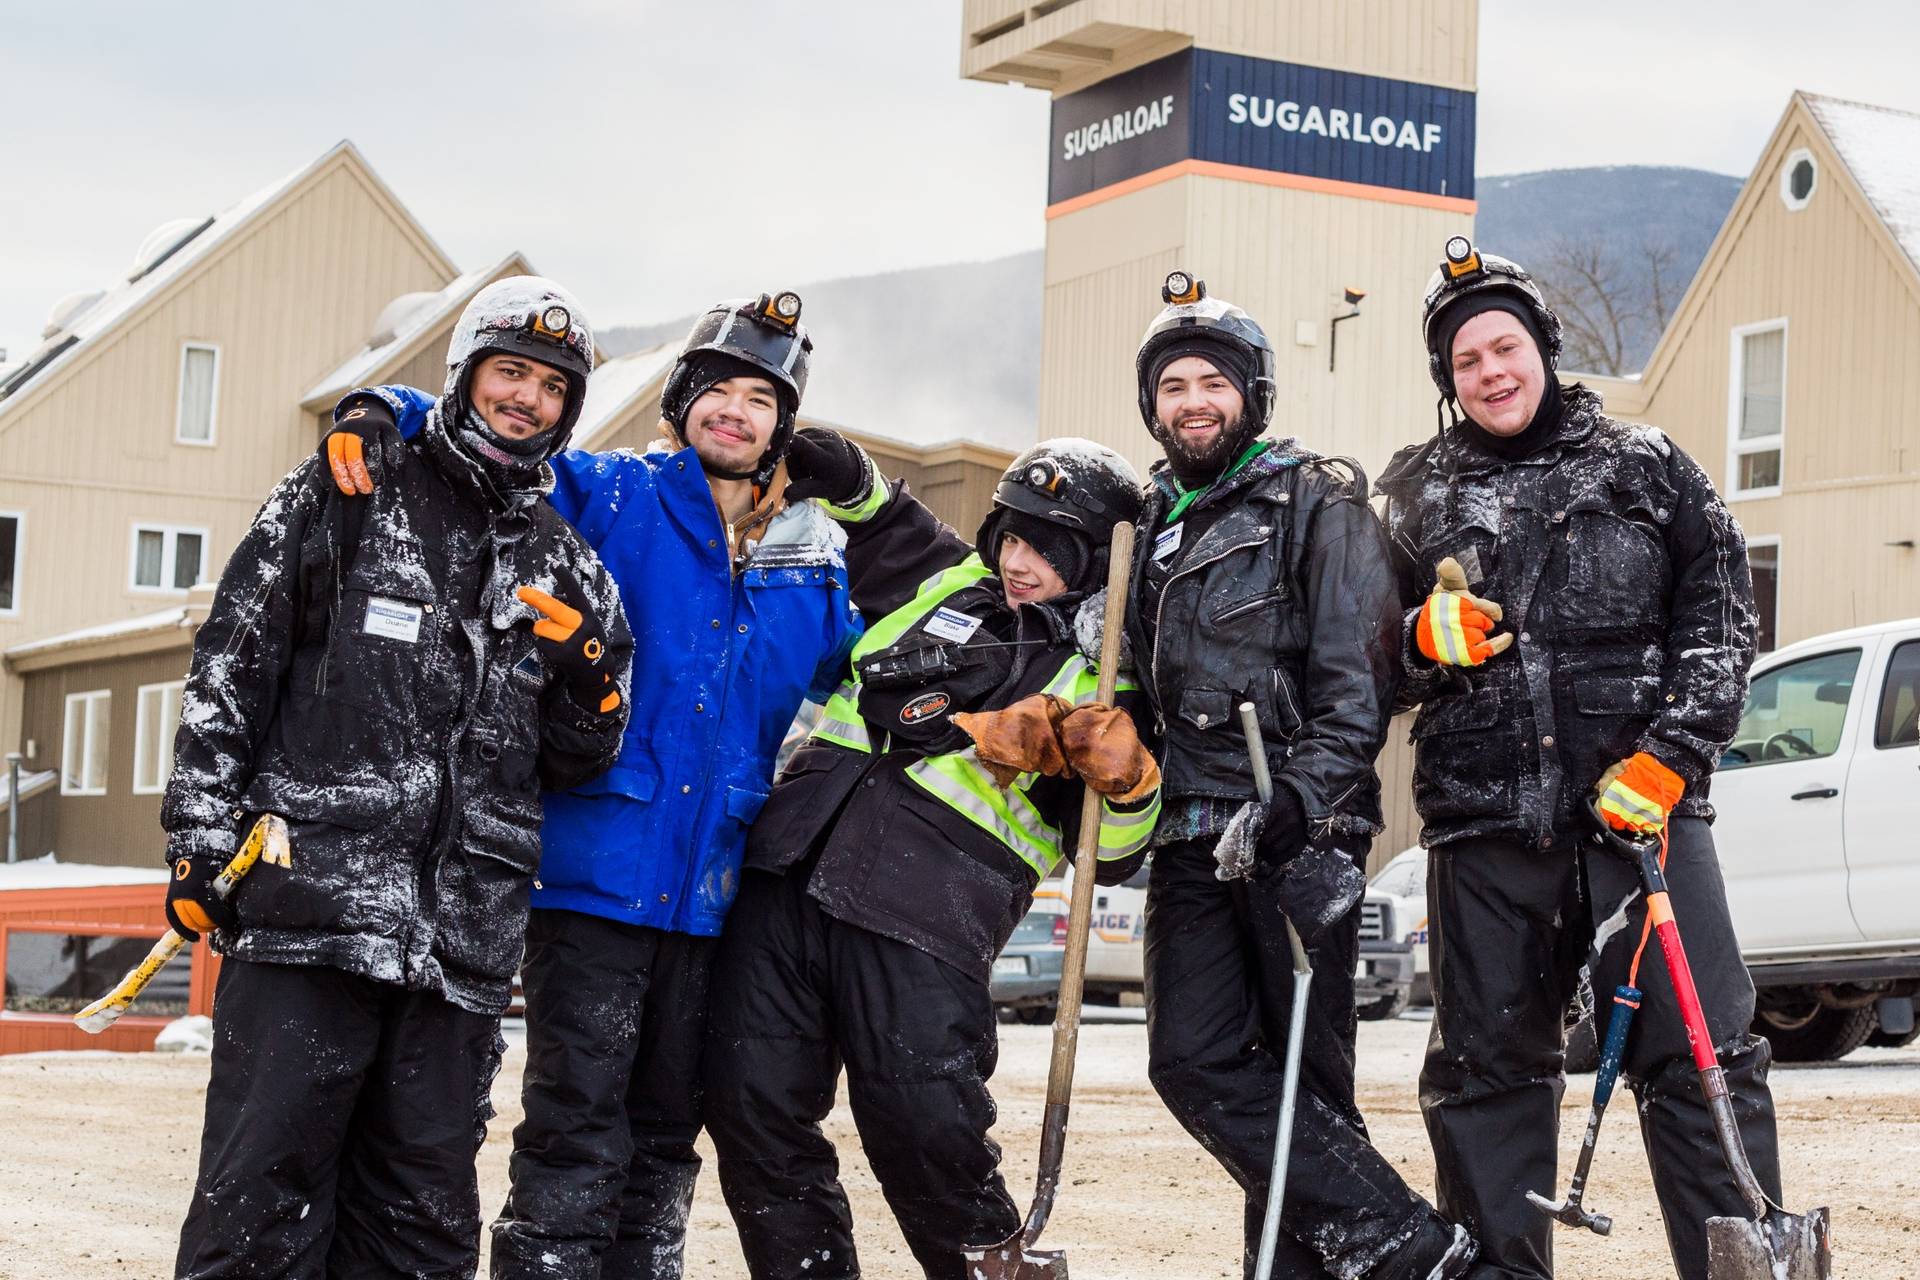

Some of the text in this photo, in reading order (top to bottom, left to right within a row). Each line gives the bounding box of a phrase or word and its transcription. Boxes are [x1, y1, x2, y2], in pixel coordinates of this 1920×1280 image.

[1063, 95, 1174, 160] SUGARLOAF
[1228, 93, 1441, 152] SUGARLOAF
[1090, 914, 1130, 929] LICE
